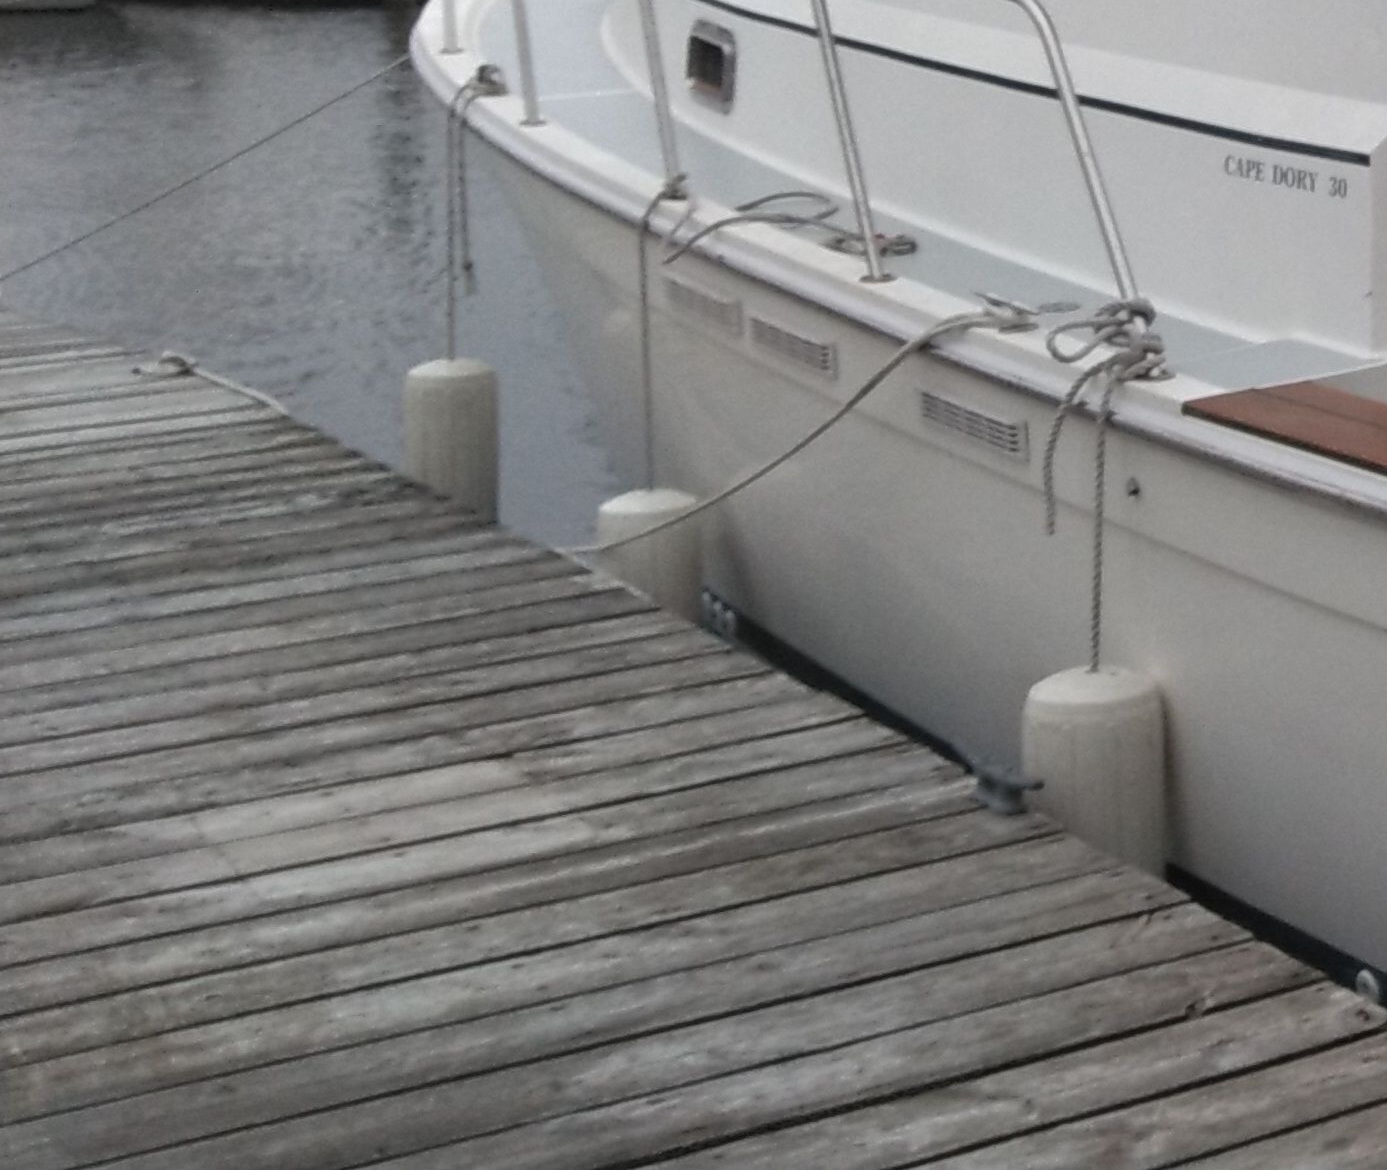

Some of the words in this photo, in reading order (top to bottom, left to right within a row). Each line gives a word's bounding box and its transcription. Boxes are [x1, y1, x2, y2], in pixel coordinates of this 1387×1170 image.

[1224, 155, 1265, 181] CAPE
[1272, 165, 1319, 192] DORY
[1328, 177, 1348, 198] 30
